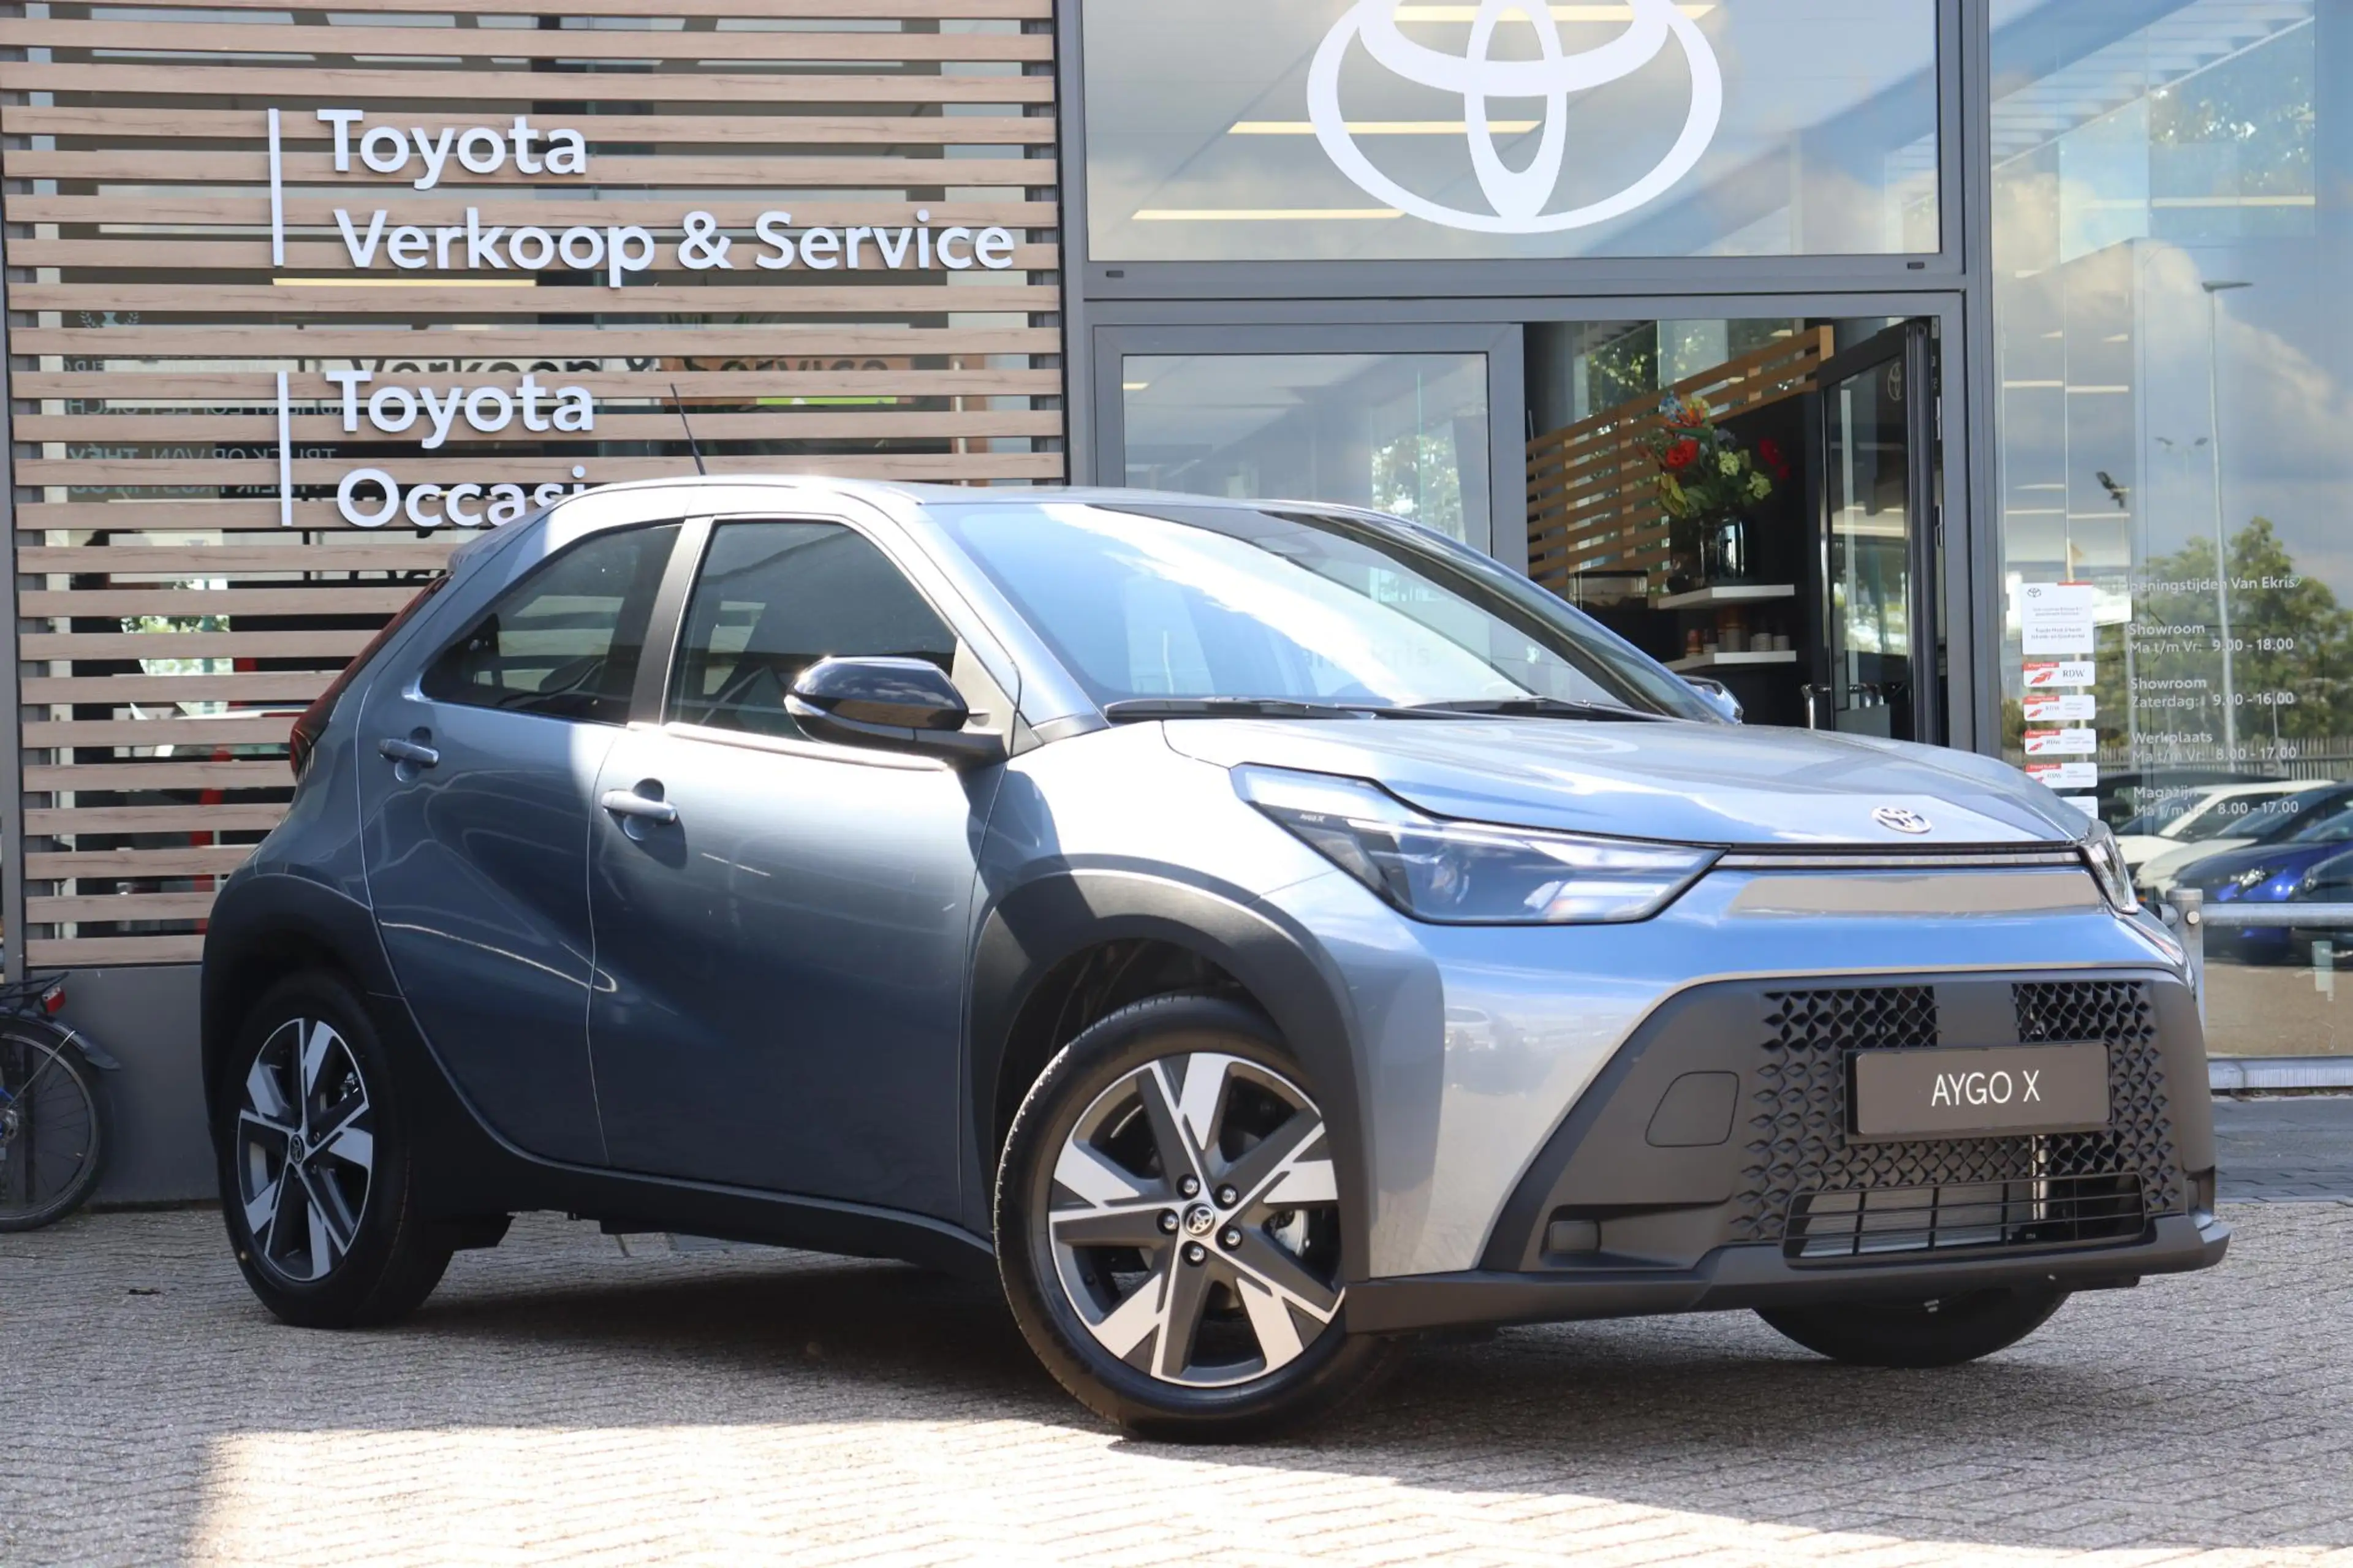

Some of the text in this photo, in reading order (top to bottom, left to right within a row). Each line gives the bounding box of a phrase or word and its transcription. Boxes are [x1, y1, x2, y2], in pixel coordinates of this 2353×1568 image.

[317, 110, 586, 190] Toyota
[334, 208, 1015, 288] Verkoop & Service
[326, 371, 594, 449] Toyota
[2131, 575, 2295, 594] peningstijden Van Ekris
[2128, 623, 2205, 635] Showroom
[2130, 642, 2150, 654] Ma
[2153, 640, 2179, 654] t/m
[2213, 638, 2243, 651] 9.00
[2256, 637, 2294, 650] 18.00
[2063, 669, 2085, 678] RDW
[2130, 678, 2207, 690] Showroom
[2131, 696, 2199, 710] Zaterdag:
[2213, 693, 2243, 706] 9.00
[2256, 692, 2294, 705] 16.00
[2132, 730, 2213, 746] Werkplaats
[2132, 749, 2153, 763] Ma
[2216, 747, 2246, 760] 8.00
[2260, 746, 2297, 760] 17.00
[2133, 785, 2198, 800] Magazijn
[2134, 804, 2154, 817] Ma
[2218, 802, 2248, 816] 8.00
[2261, 800, 2299, 814] 17.00
[1931, 1070, 2040, 1107] AYGO X
